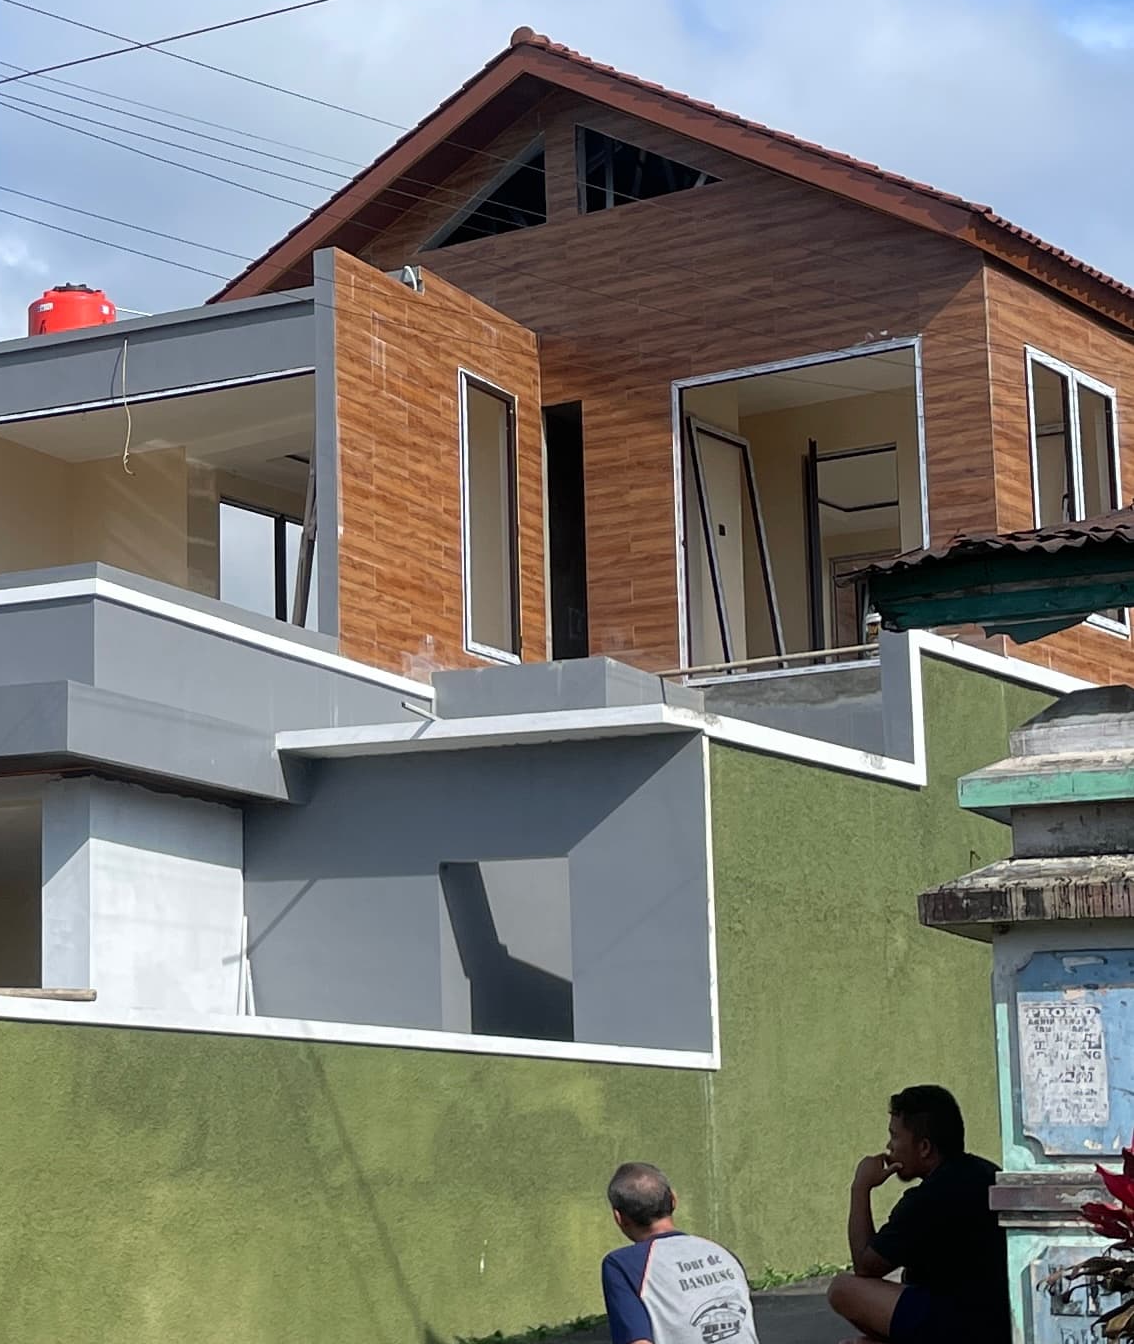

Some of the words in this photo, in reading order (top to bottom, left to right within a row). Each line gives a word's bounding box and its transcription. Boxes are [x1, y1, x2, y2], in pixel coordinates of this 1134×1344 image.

[676, 1258, 704, 1273] Tour
[707, 1254, 722, 1266] de
[678, 1268, 735, 1292] BANDUNG
